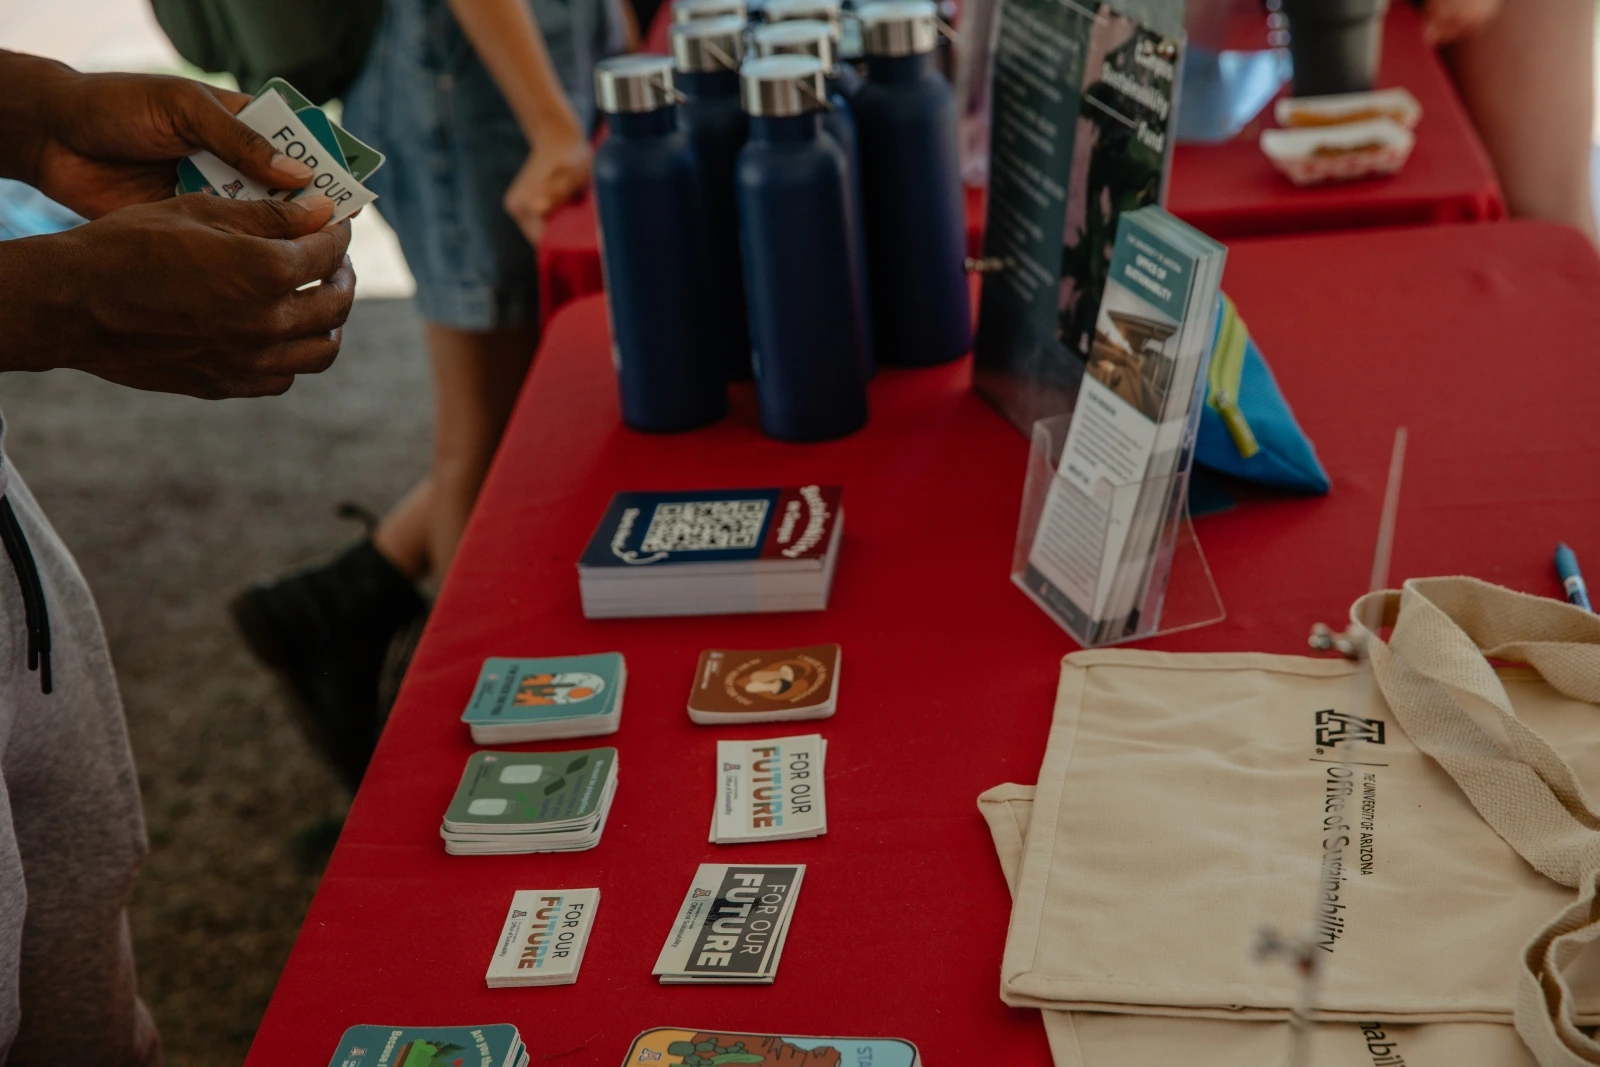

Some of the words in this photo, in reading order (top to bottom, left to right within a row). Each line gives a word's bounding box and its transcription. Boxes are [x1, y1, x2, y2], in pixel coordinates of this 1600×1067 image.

[314, 173, 353, 207] OUR
[789, 752, 810, 780] FOR
[752, 745, 784, 828] FUTURE
[790, 784, 812, 814] OUR
[1325, 767, 1354, 813] Office
[1361, 783, 1376, 819] UNIVERSITY
[1323, 815, 1350, 832] of
[1360, 819, 1374, 831] OF
[1360, 832, 1374, 876] ARIZONA
[561, 903, 585, 928] FOR
[755, 884, 786, 914] FOR
[517, 895, 565, 970] FUTURE
[696, 873, 765, 967] FUTURE
[551, 932, 575, 959] OUR
[739, 919, 772, 955] OUR
[379, 1030, 403, 1063] Because
[470, 1029, 485, 1043] Are
[476, 1041, 490, 1057] you
[1359, 1021, 1407, 1067] nabil
